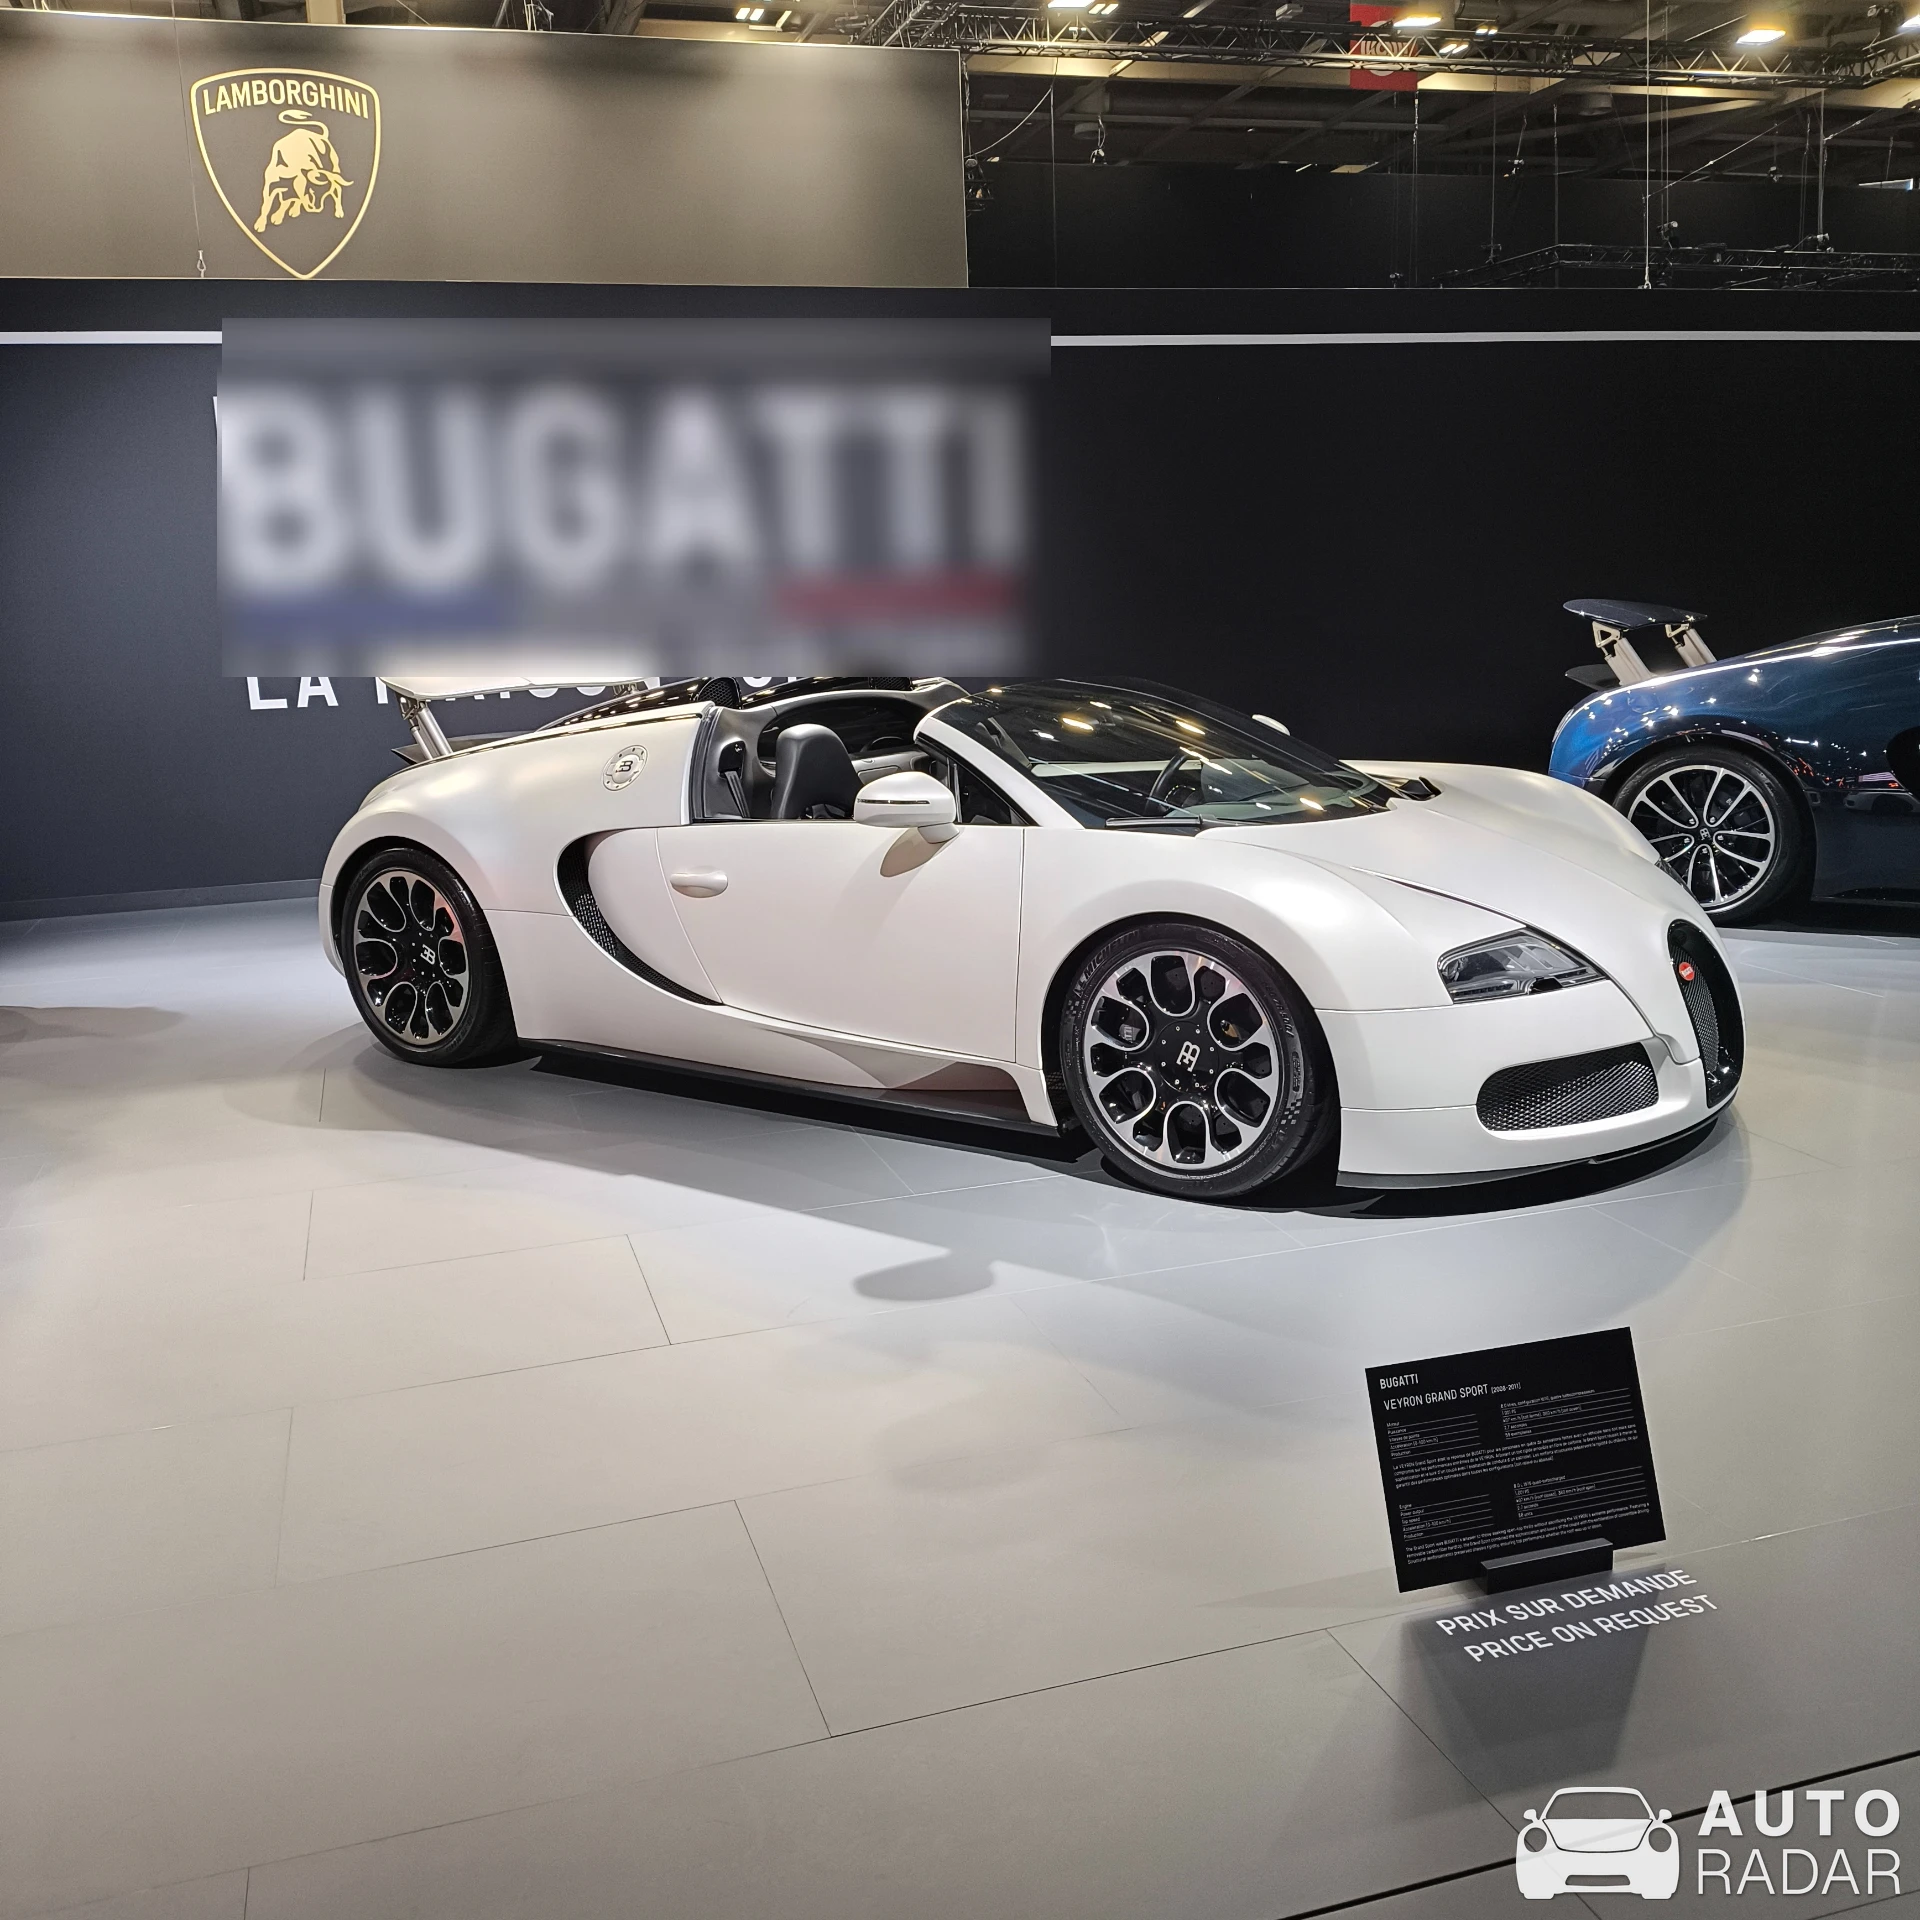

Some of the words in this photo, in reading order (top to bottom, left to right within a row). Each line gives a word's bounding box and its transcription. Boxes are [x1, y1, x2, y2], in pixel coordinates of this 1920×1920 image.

[203, 79, 369, 119] LAMBORGHINI
[1379, 1373, 1419, 1390] BUGATTI
[1384, 1395, 1423, 1411] VEYRON
[1425, 1389, 1457, 1405] GRAND
[1459, 1383, 1489, 1399] SPORT
[1436, 1609, 1507, 1636] PRIX
[1505, 1597, 1565, 1621] SUR
[1561, 1569, 1698, 1609] DEMANDE
[1464, 1630, 1553, 1662] PRICE
[1551, 1621, 1597, 1643] ON
[1593, 1594, 1718, 1634] REQUEST
